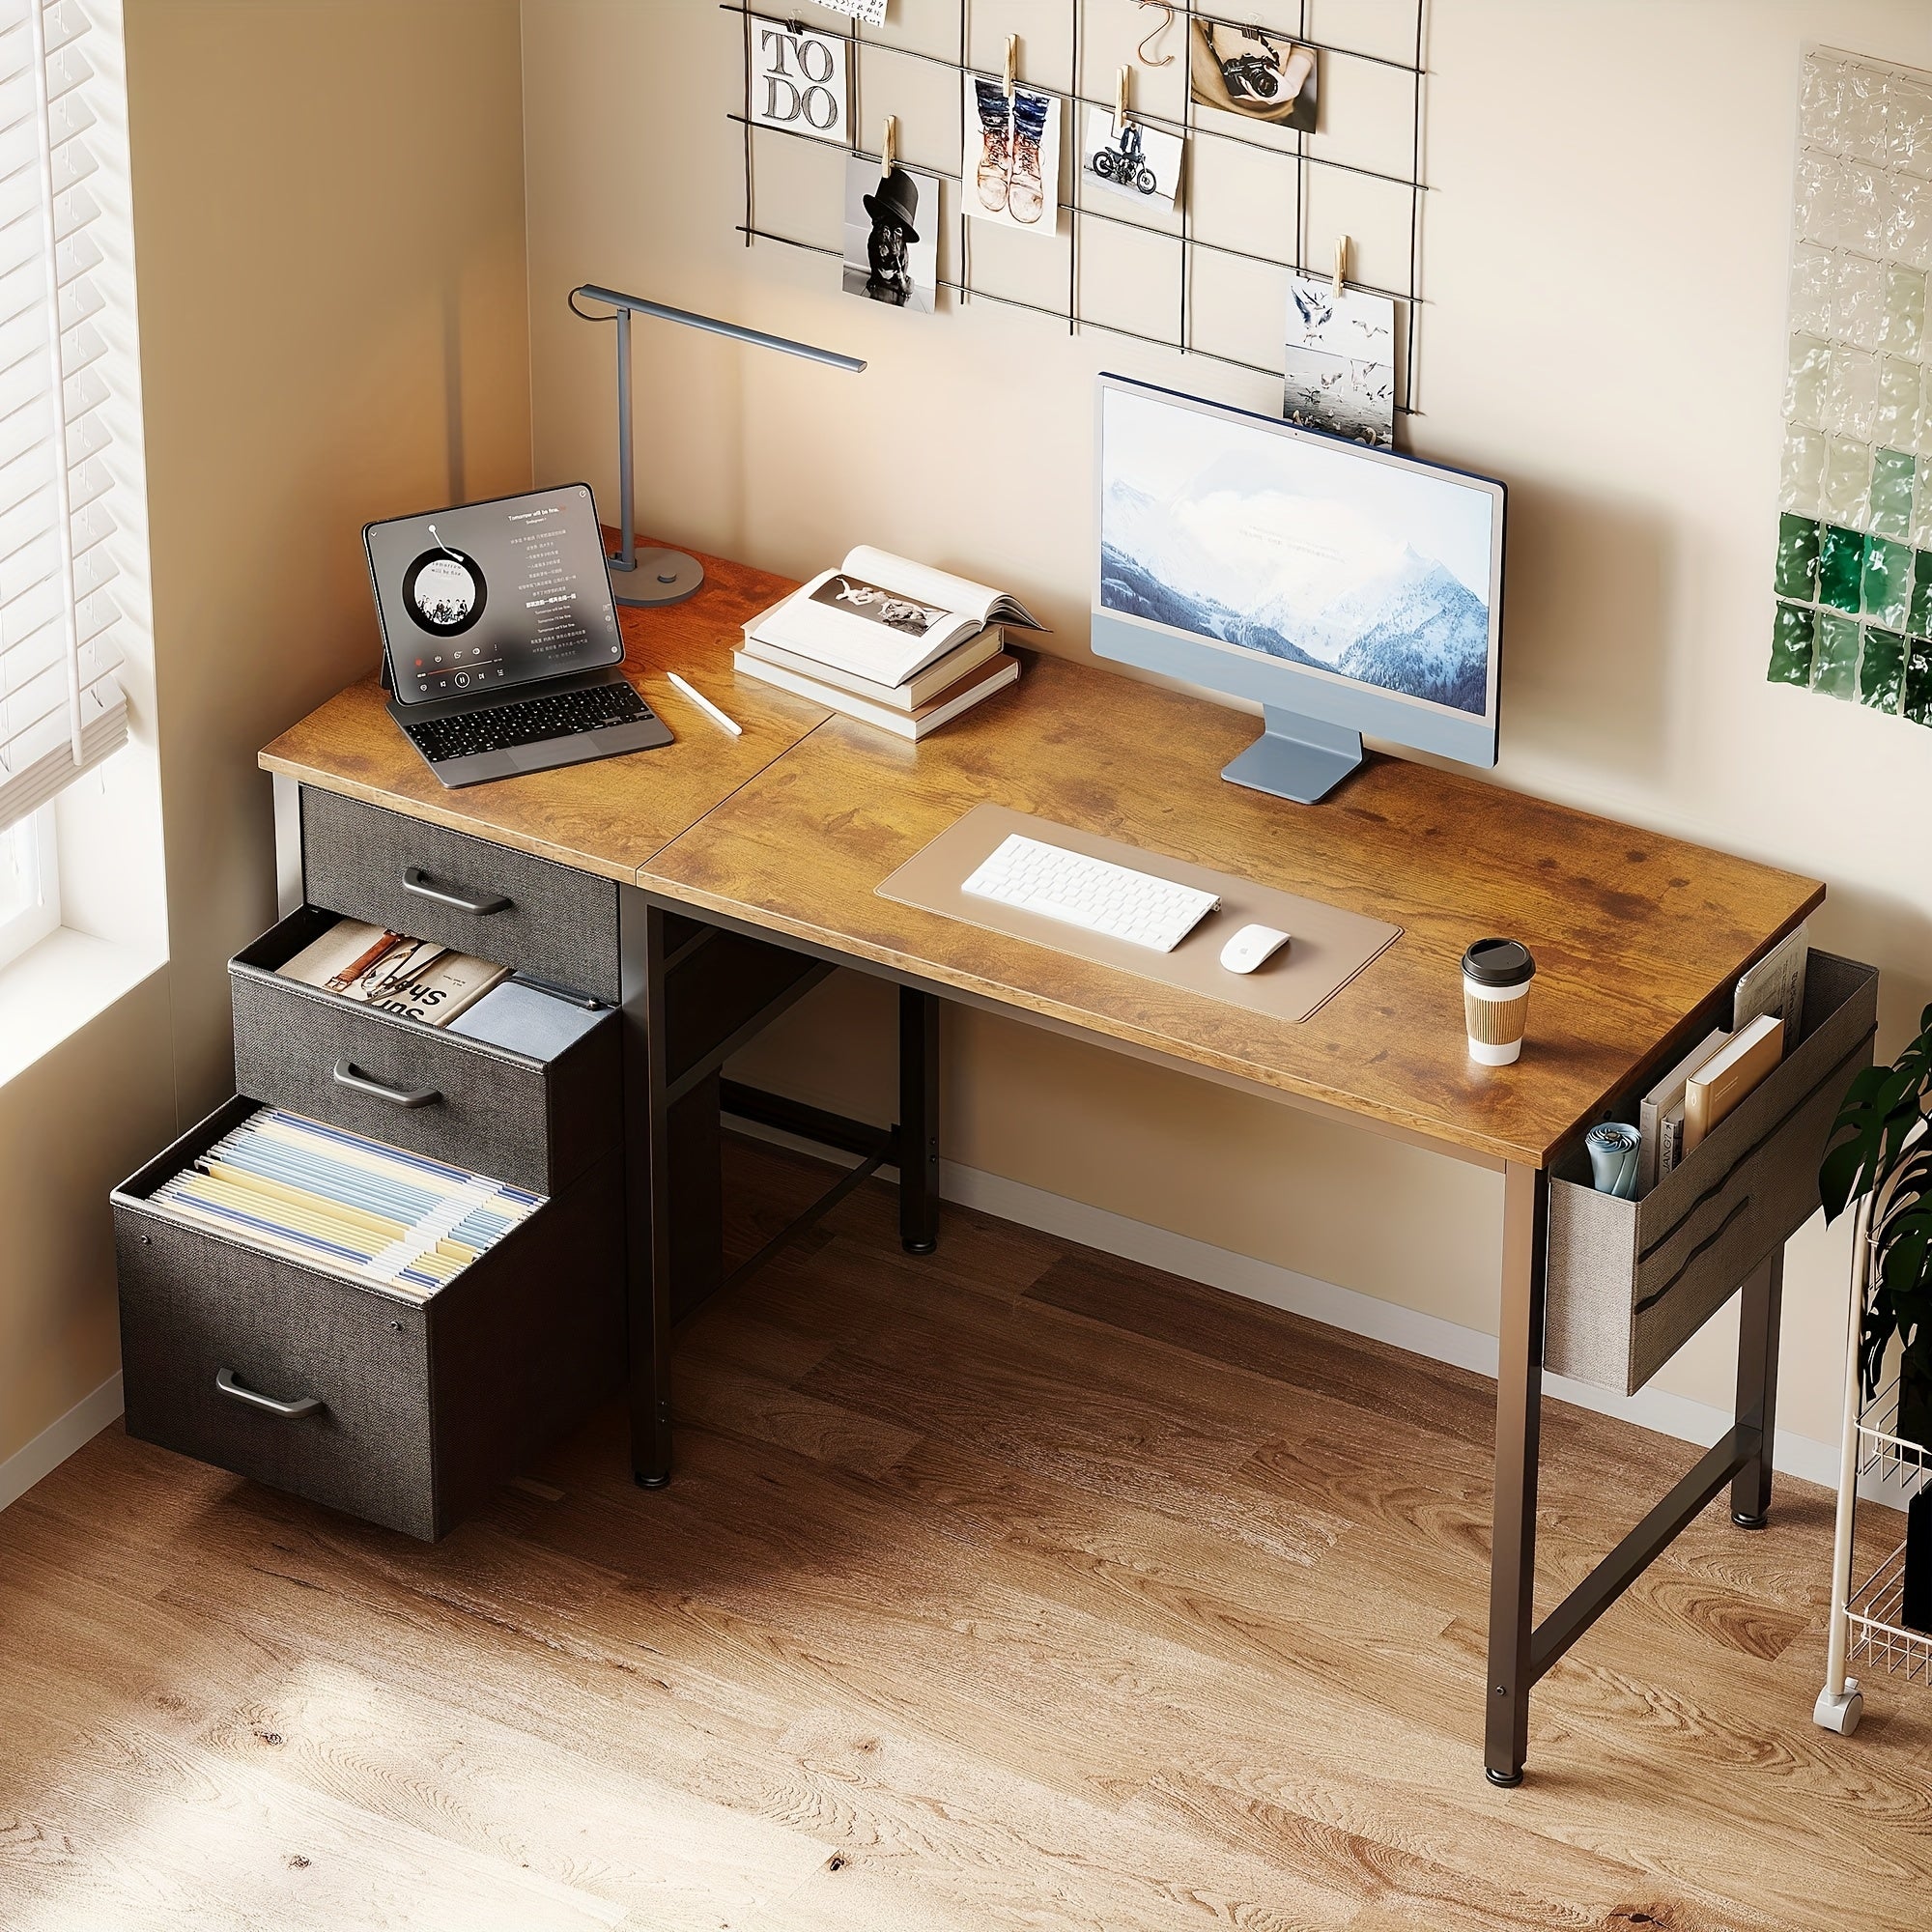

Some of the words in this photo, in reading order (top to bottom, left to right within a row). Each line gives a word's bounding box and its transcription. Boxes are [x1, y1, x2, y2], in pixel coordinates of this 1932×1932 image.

[761, 29, 835, 84] TO
[761, 74, 838, 130] DO
[508, 513, 532, 522] Tomorrow
